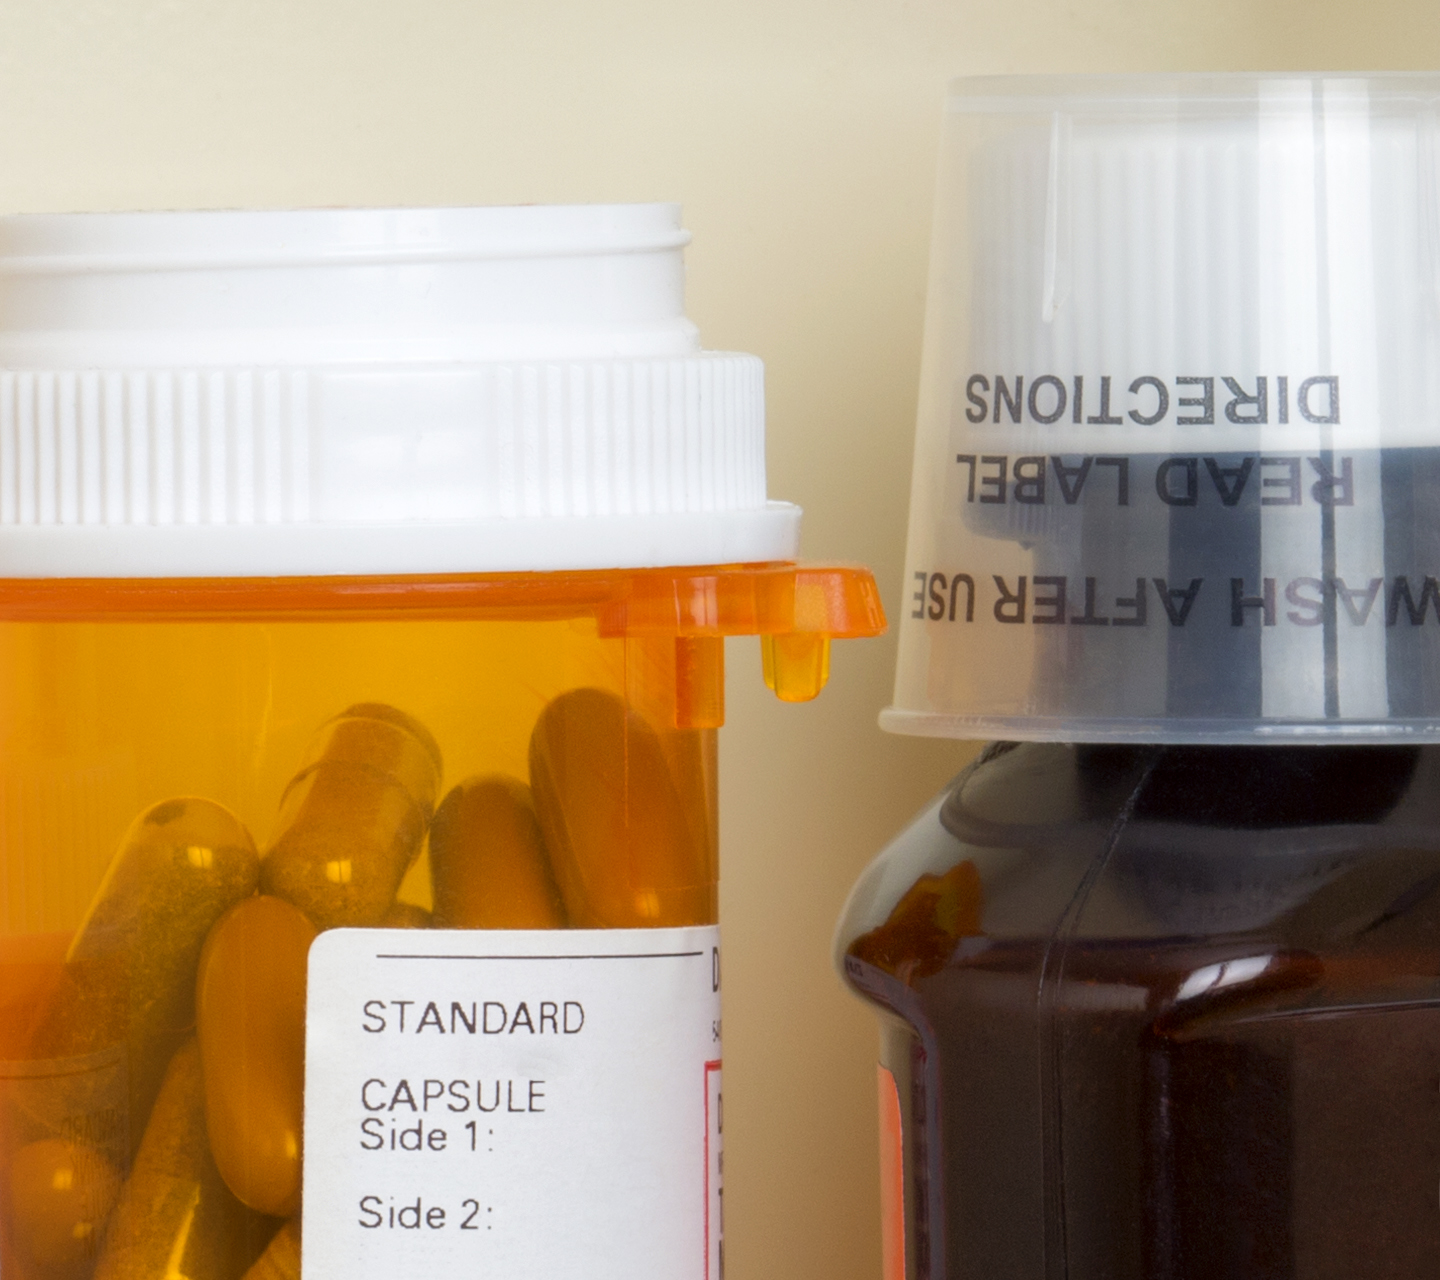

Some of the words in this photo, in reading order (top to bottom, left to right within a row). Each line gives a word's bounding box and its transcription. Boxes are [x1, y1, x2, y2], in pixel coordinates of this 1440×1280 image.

[966, 373, 1340, 426] DIRECTIONS
[956, 454, 1129, 506] LABEL
[1155, 456, 1355, 506] READ
[912, 571, 974, 622] USE
[992, 573, 1203, 627] AFTER
[1229, 574, 1440, 627] WASH
[362, 999, 585, 1035] STANDARD
[361, 1078, 546, 1113] CAPSULE
[359, 1117, 448, 1152] Side
[464, 1120, 494, 1152] 1:
[358, 1195, 446, 1230] Side
[459, 1198, 493, 1230] 2:
